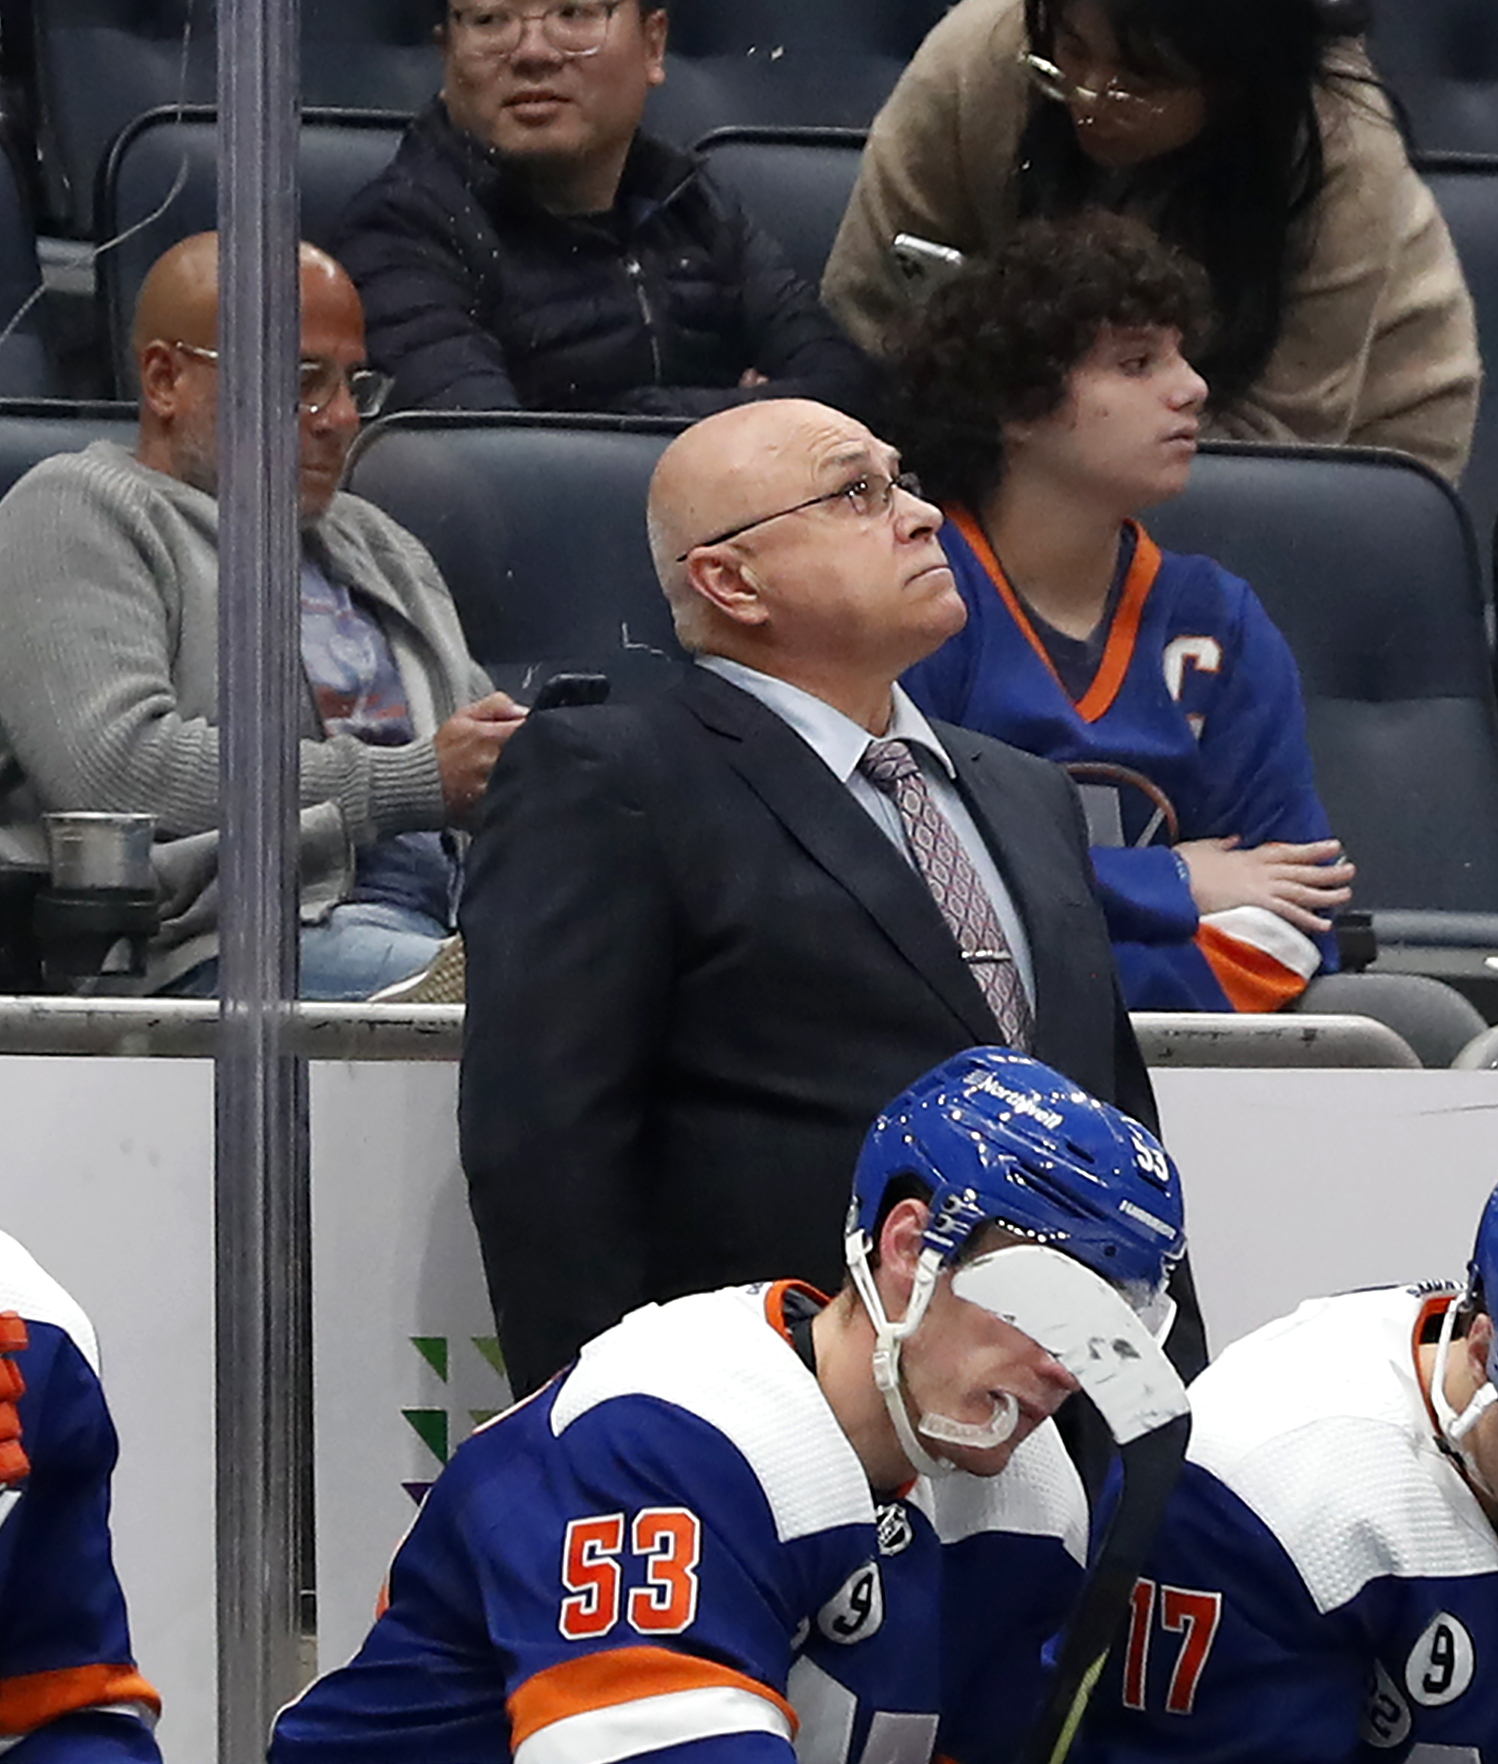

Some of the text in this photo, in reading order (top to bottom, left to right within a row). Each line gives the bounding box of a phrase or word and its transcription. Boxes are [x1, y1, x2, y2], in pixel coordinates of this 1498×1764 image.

[558, 1506, 701, 1641] 53
[832, 1572, 875, 1637] 9
[1122, 1576, 1223, 1716] 17
[1422, 1624, 1456, 1695] 9
